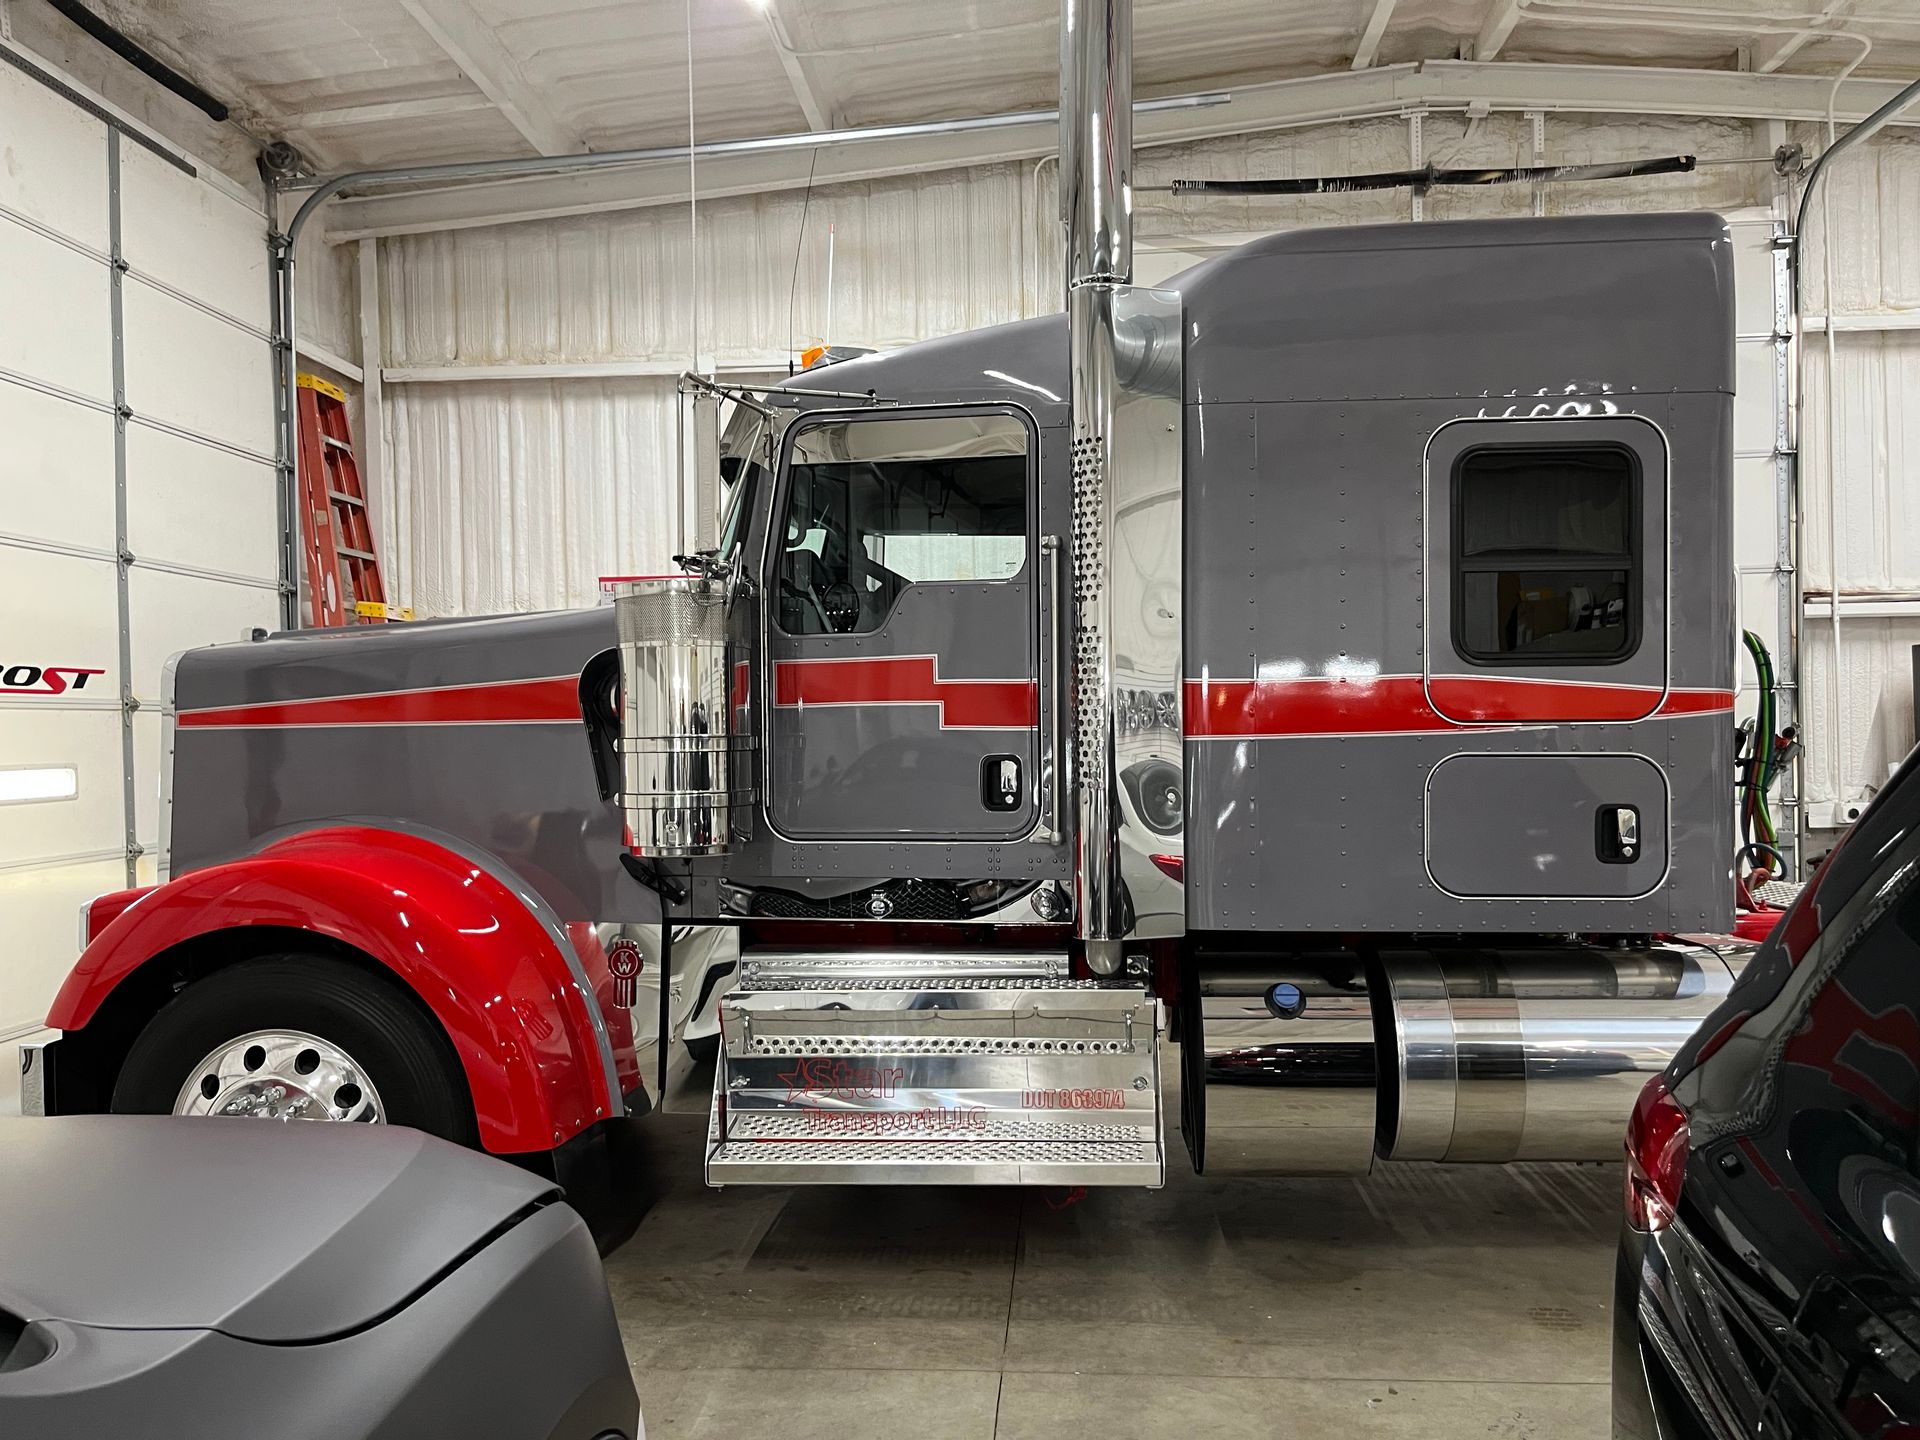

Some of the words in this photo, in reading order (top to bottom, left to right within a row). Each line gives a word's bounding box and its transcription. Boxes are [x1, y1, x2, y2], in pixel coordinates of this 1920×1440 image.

[0, 665, 105, 694] OST
[804, 1058, 903, 1099] Star
[1022, 1089, 1056, 1109] DOT
[1059, 1089, 1125, 1109] 863974
[803, 1108, 934, 1135] Transport
[938, 1106, 986, 1129] LLC
